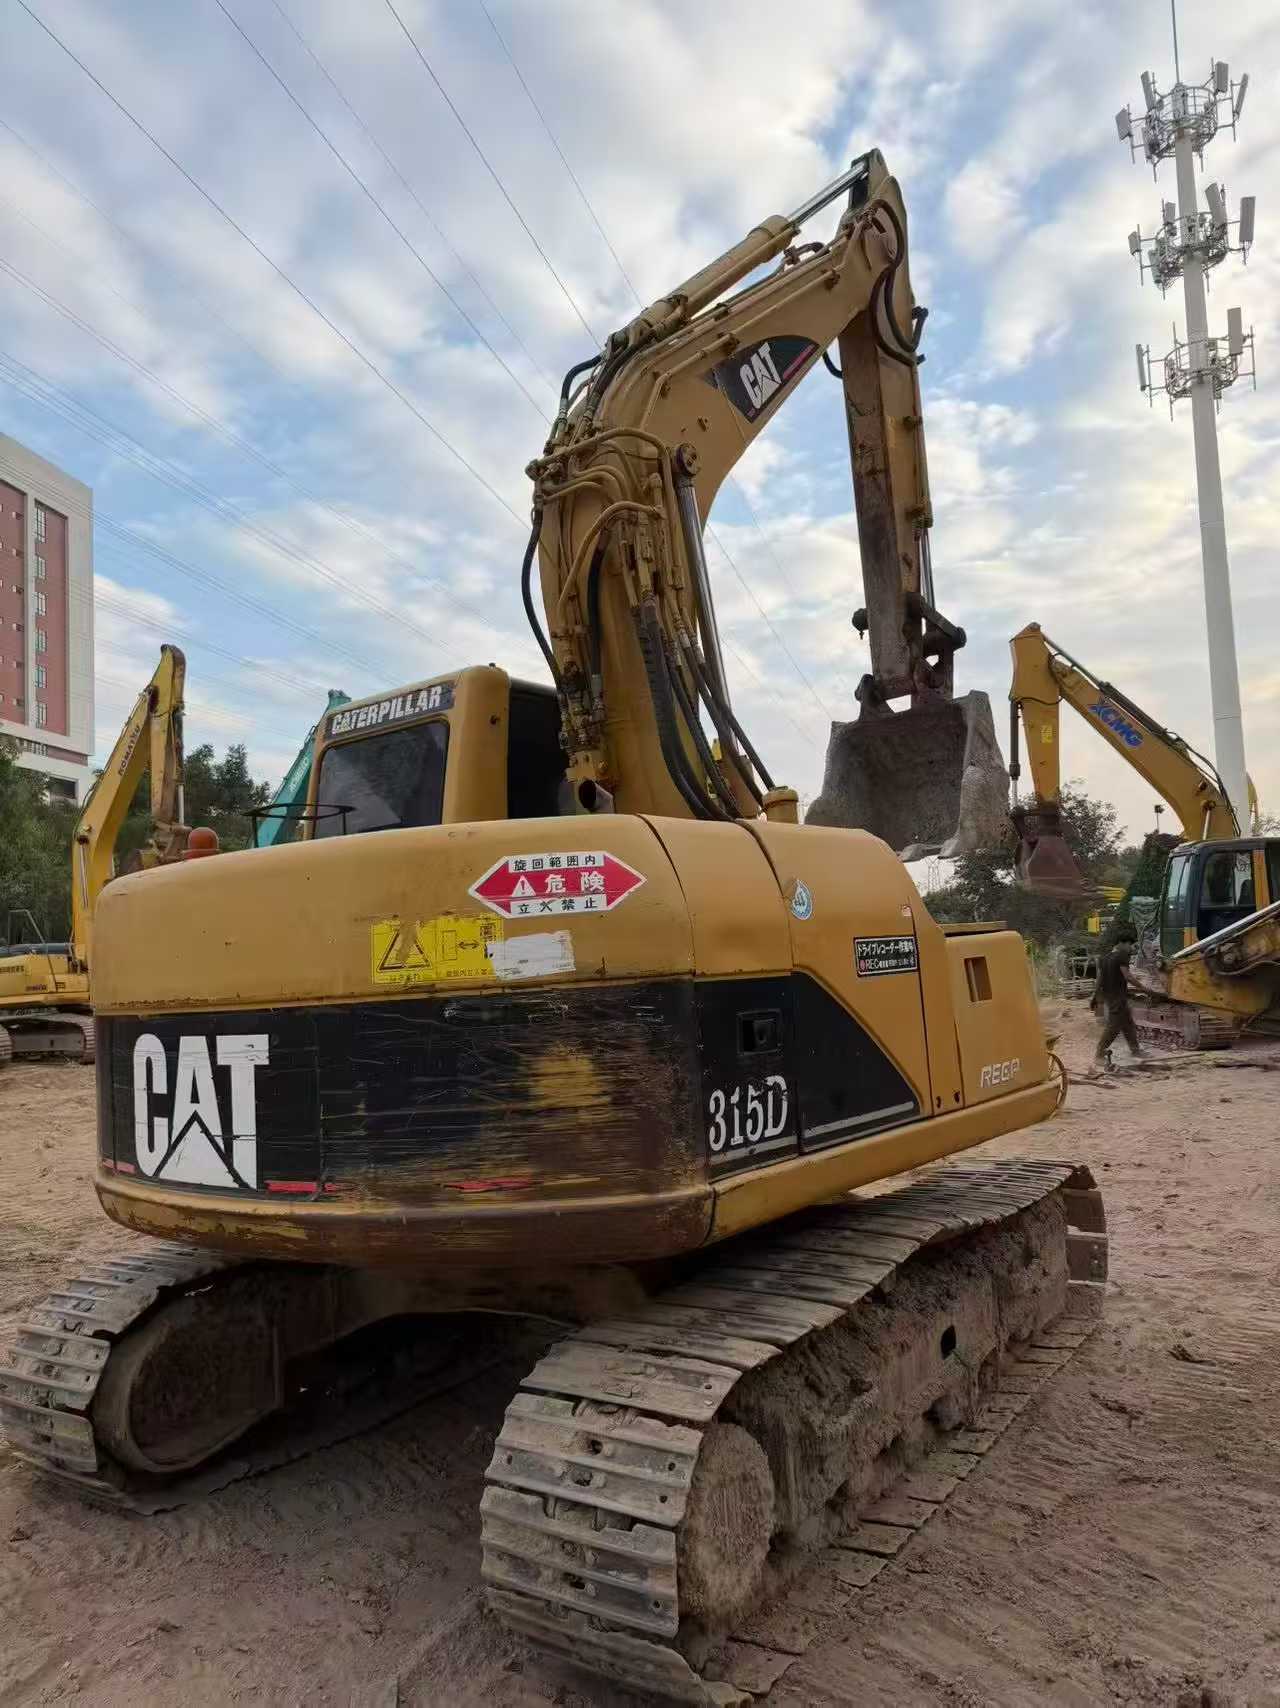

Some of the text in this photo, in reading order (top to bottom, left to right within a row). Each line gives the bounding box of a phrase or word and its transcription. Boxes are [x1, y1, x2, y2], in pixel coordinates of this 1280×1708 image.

[740, 342, 782, 409] CAT
[332, 685, 443, 735] CATERPILLAR
[1088, 701, 1143, 748] XCMG
[514, 855, 596, 871] 旋回範囲内
[545, 871, 605, 894] 危険
[518, 897, 598, 914] 立入禁止
[133, 1033, 270, 1190] CAT
[709, 1075, 788, 1151] 315D
